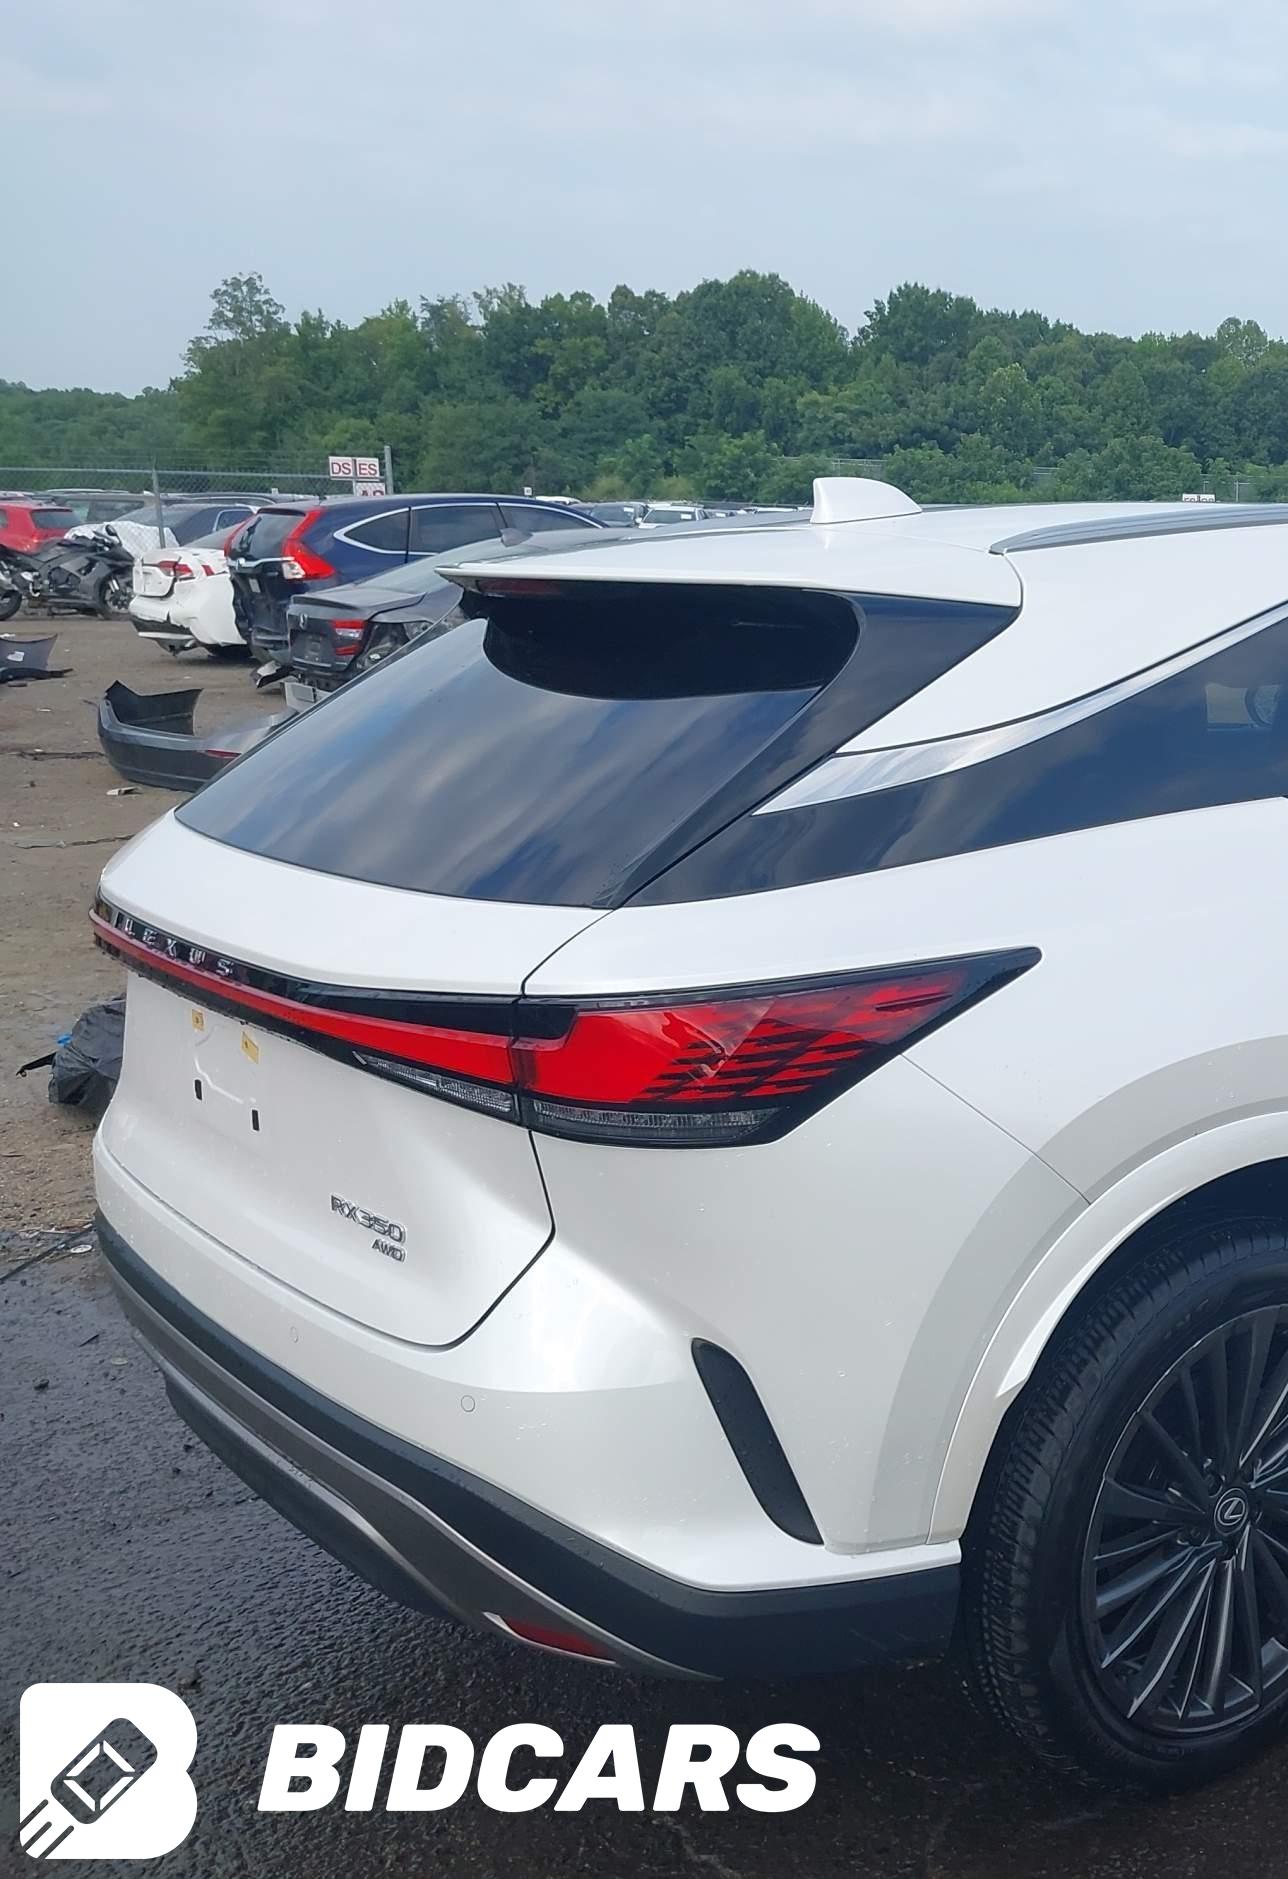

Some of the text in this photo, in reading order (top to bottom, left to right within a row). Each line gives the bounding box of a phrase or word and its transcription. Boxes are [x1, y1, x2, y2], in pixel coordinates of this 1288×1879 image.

[331, 462, 351, 475] DS
[358, 463, 377, 476] ES
[124, 918, 234, 977] LEXUS
[371, 1239, 406, 1262] AWD
